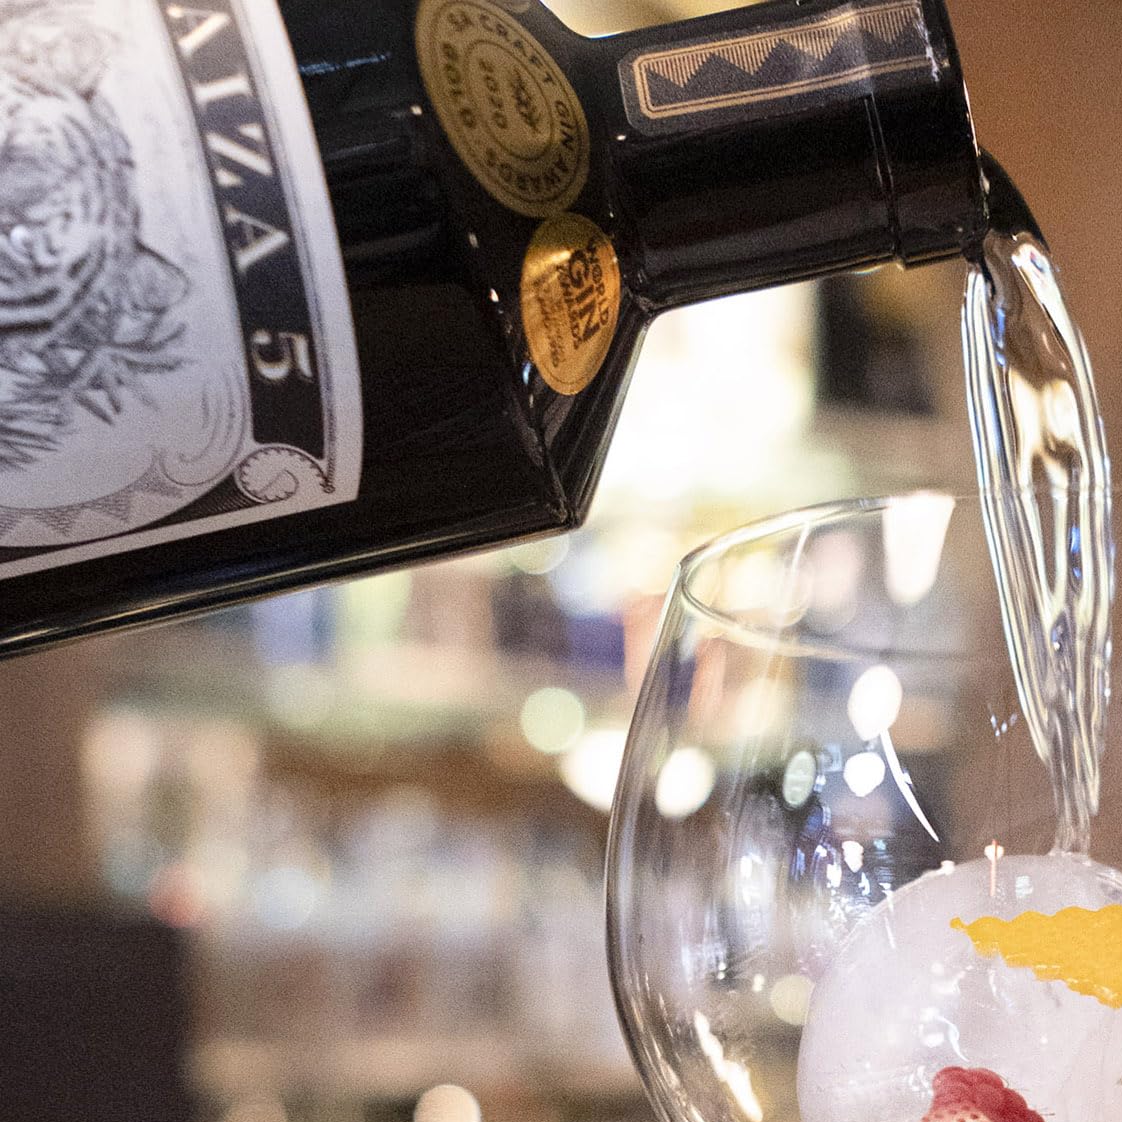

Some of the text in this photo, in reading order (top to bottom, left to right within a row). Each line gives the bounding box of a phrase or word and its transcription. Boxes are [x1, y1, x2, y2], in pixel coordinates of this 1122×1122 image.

[441, 41, 478, 129] GOLD
[479, 13, 556, 87] CRAFT
[478, 59, 508, 130] 2020
[554, 99, 580, 151] GIN
[165, 3, 313, 381] AIZA 5
[484, 150, 569, 192] AWARDS
[569, 249, 600, 343] GIN
[587, 235, 609, 327] WORLD
